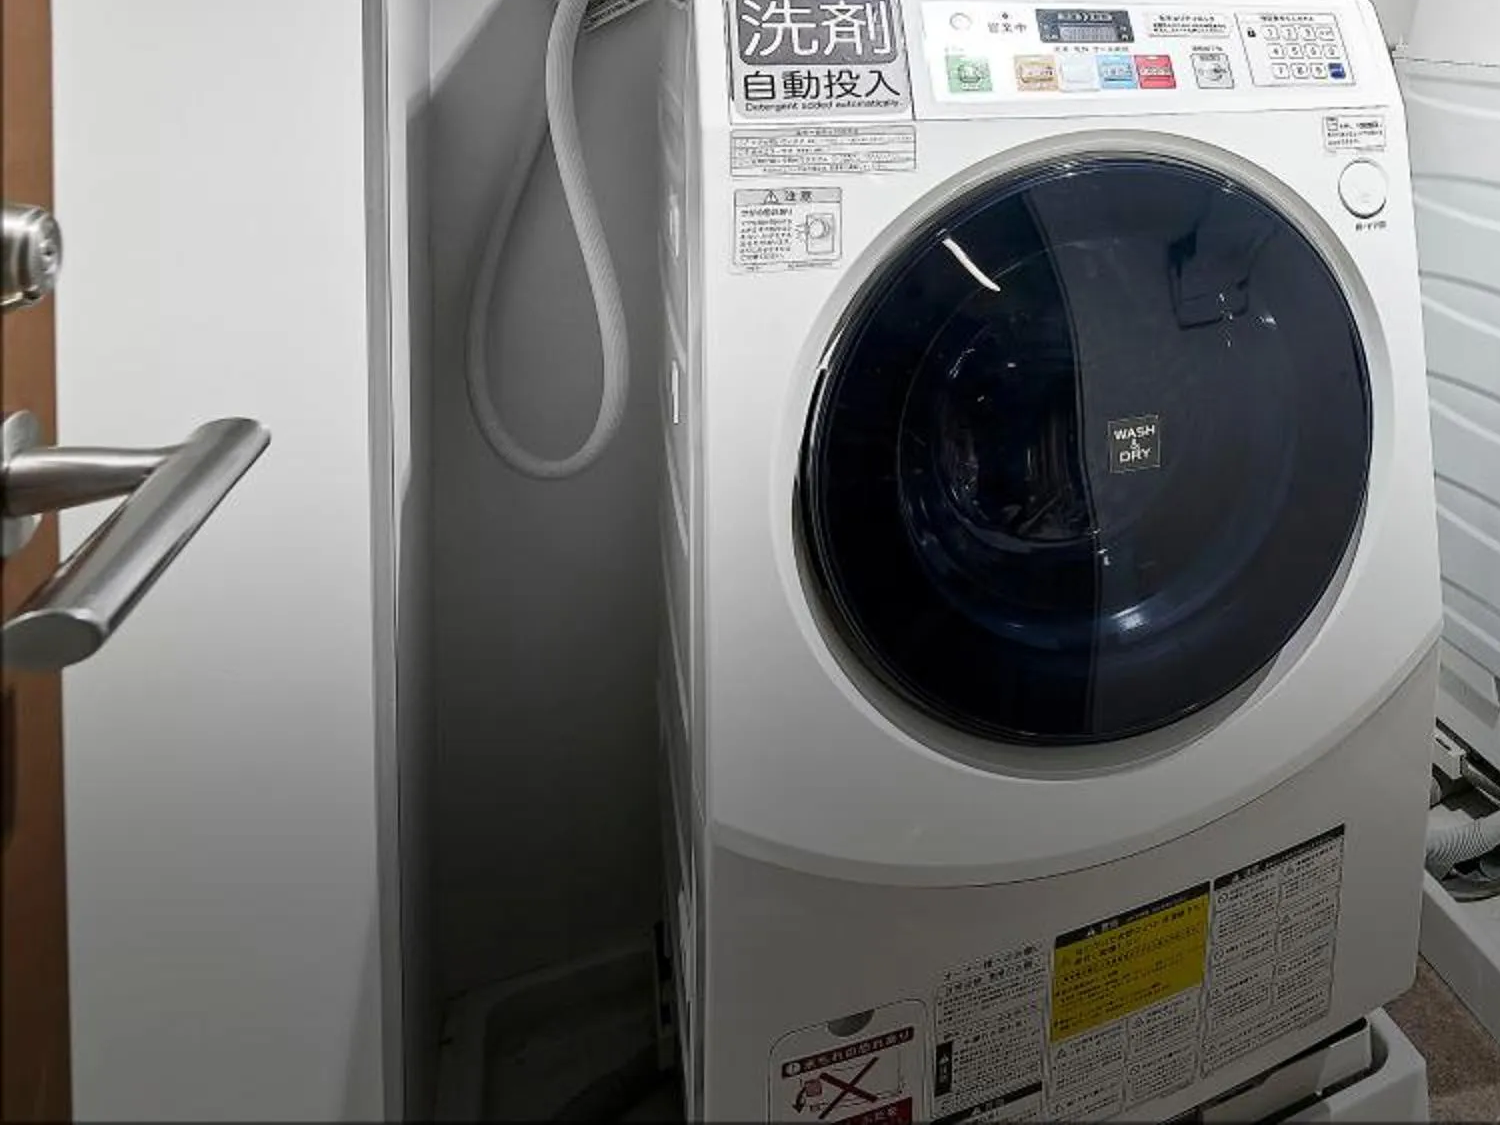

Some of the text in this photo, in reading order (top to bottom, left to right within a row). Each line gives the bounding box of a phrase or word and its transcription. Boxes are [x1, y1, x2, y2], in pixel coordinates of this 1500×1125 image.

[743, 69, 901, 101] 自動投入
[745, 101, 798, 113] Detergent
[802, 100, 833, 110] added
[1113, 424, 1156, 440] WASH
[1119, 447, 1151, 463] DRY
